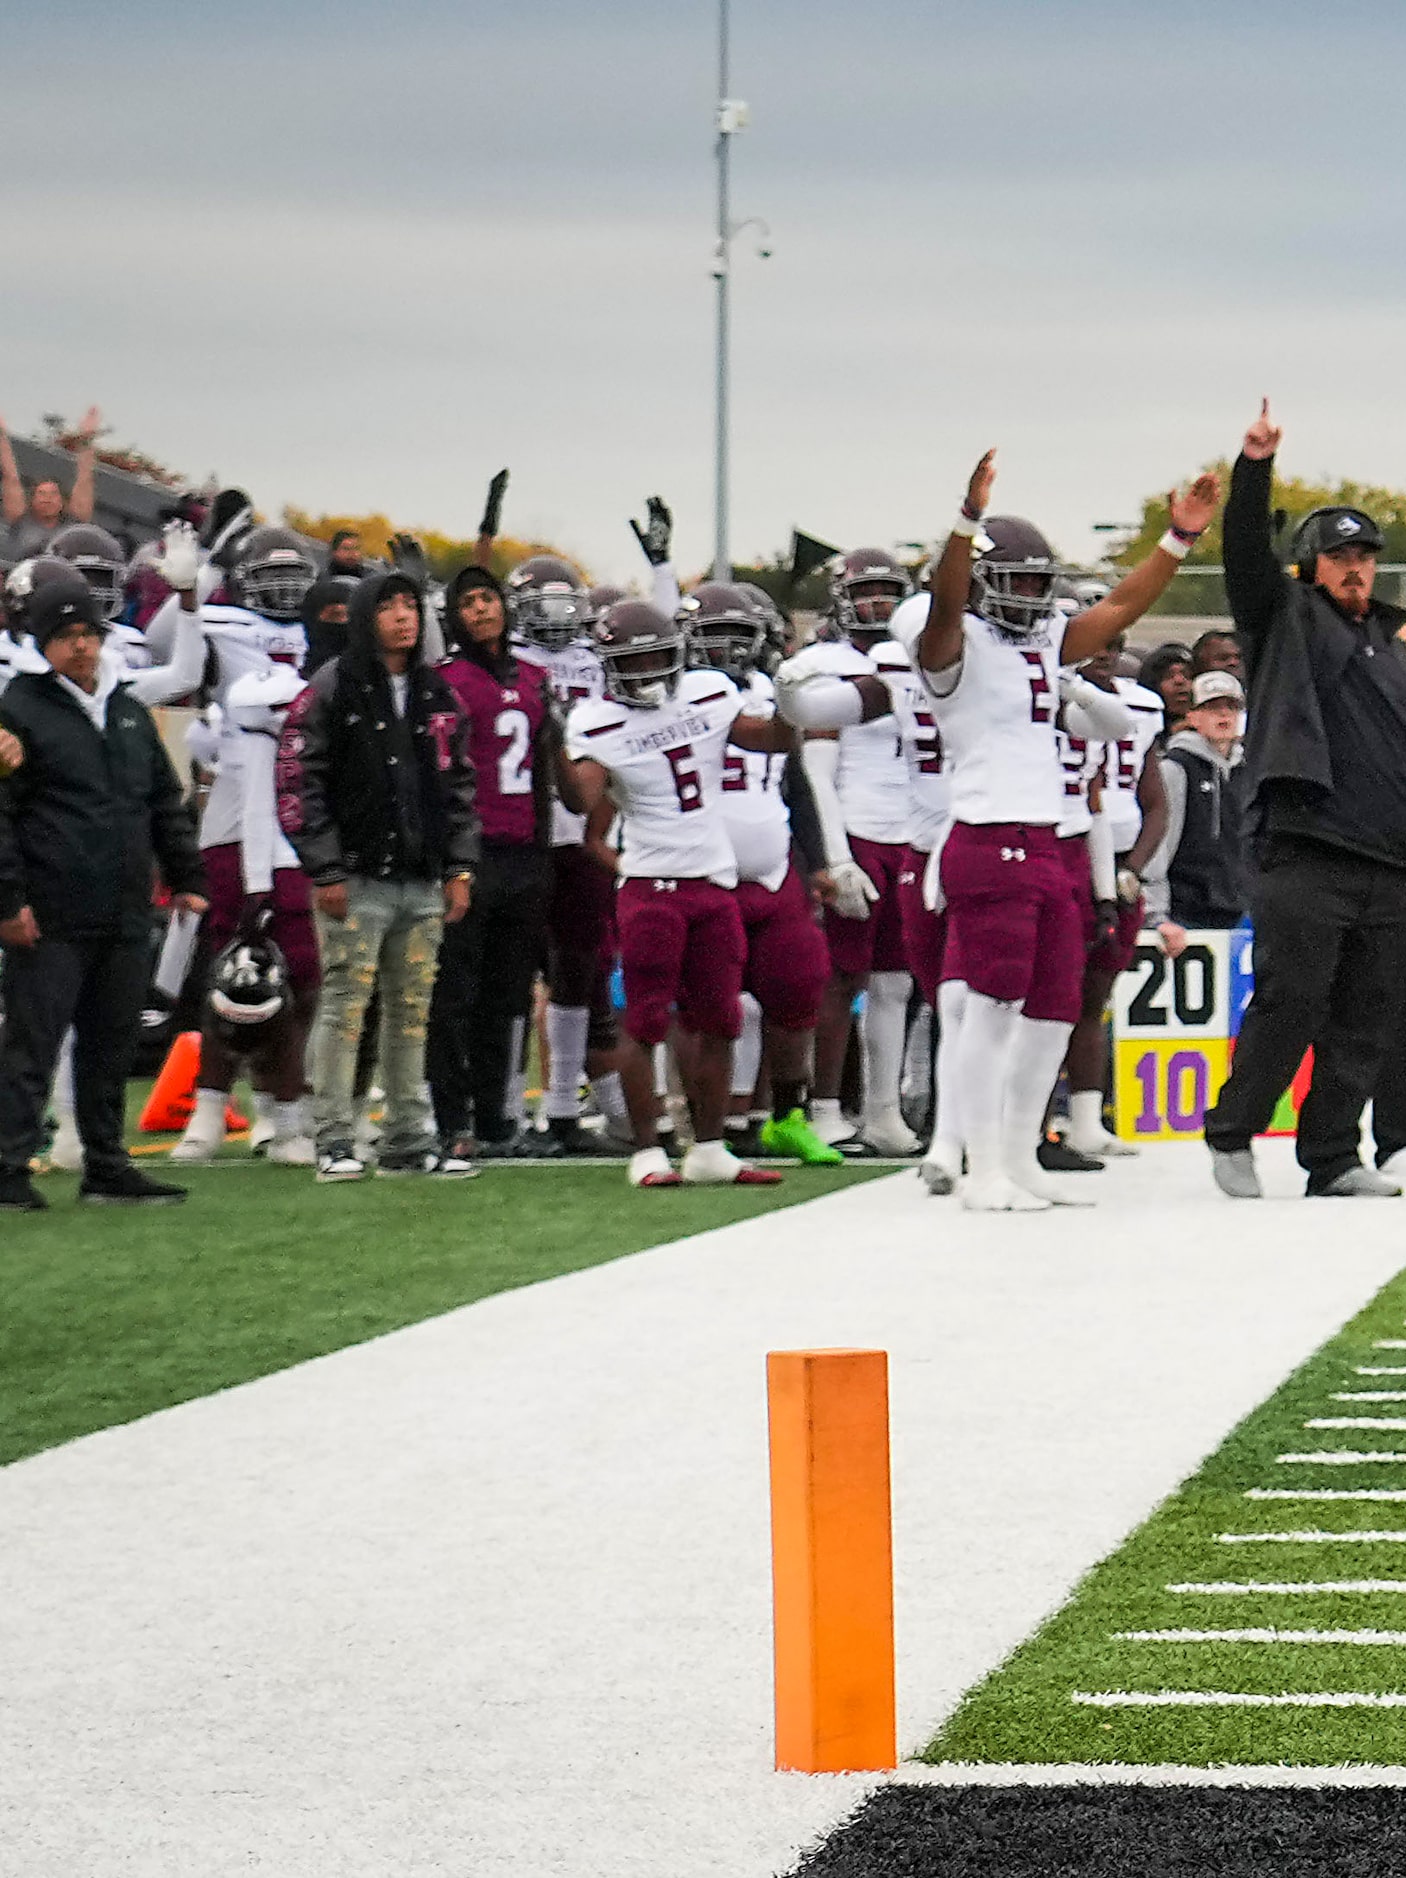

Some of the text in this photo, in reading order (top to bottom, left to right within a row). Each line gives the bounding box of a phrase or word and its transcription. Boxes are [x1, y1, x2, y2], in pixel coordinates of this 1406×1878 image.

[493, 708, 533, 795] 2
[662, 743, 704, 812] 6
[1128, 945, 1215, 1026] 20
[1135, 1051, 1209, 1134] 10
